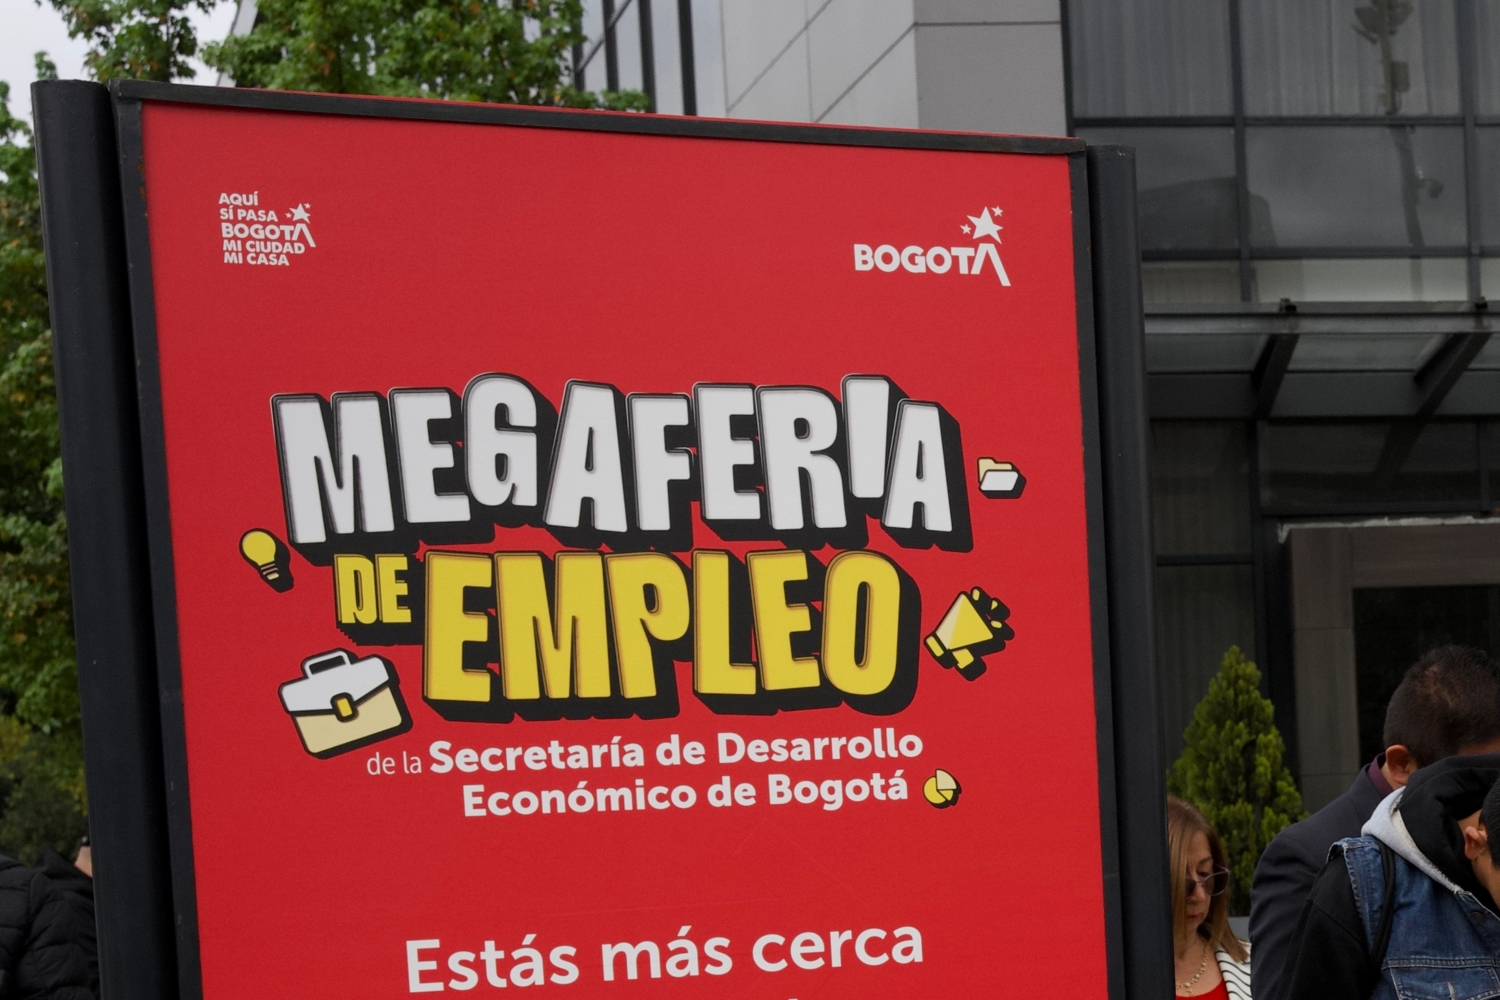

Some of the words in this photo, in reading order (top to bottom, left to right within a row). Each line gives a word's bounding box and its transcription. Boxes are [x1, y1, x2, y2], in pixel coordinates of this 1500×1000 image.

[219, 191, 259, 206] AQUÍ
[220, 205, 234, 220] SÍ
[237, 208, 279, 222] PASA
[223, 239, 242, 252] MI
[246, 240, 305, 254] CIUDAD
[224, 252, 243, 264] MI
[246, 253, 290, 266] CASA
[271, 373, 957, 547] MEGAFERIA
[335, 555, 413, 625] DE
[424, 551, 903, 703] EMPLEO
[366, 751, 396, 776] de
[402, 750, 422, 774] la
[429, 735, 645, 774] Secretaría
[655, 733, 706, 767] de
[717, 727, 924, 765] Desarrollo
[462, 778, 697, 817] Económico
[707, 775, 757, 808] de
[767, 769, 909, 812] Bogotá
[406, 934, 580, 993] Estás
[601, 926, 733, 982] más
[752, 926, 924, 973] cerca
